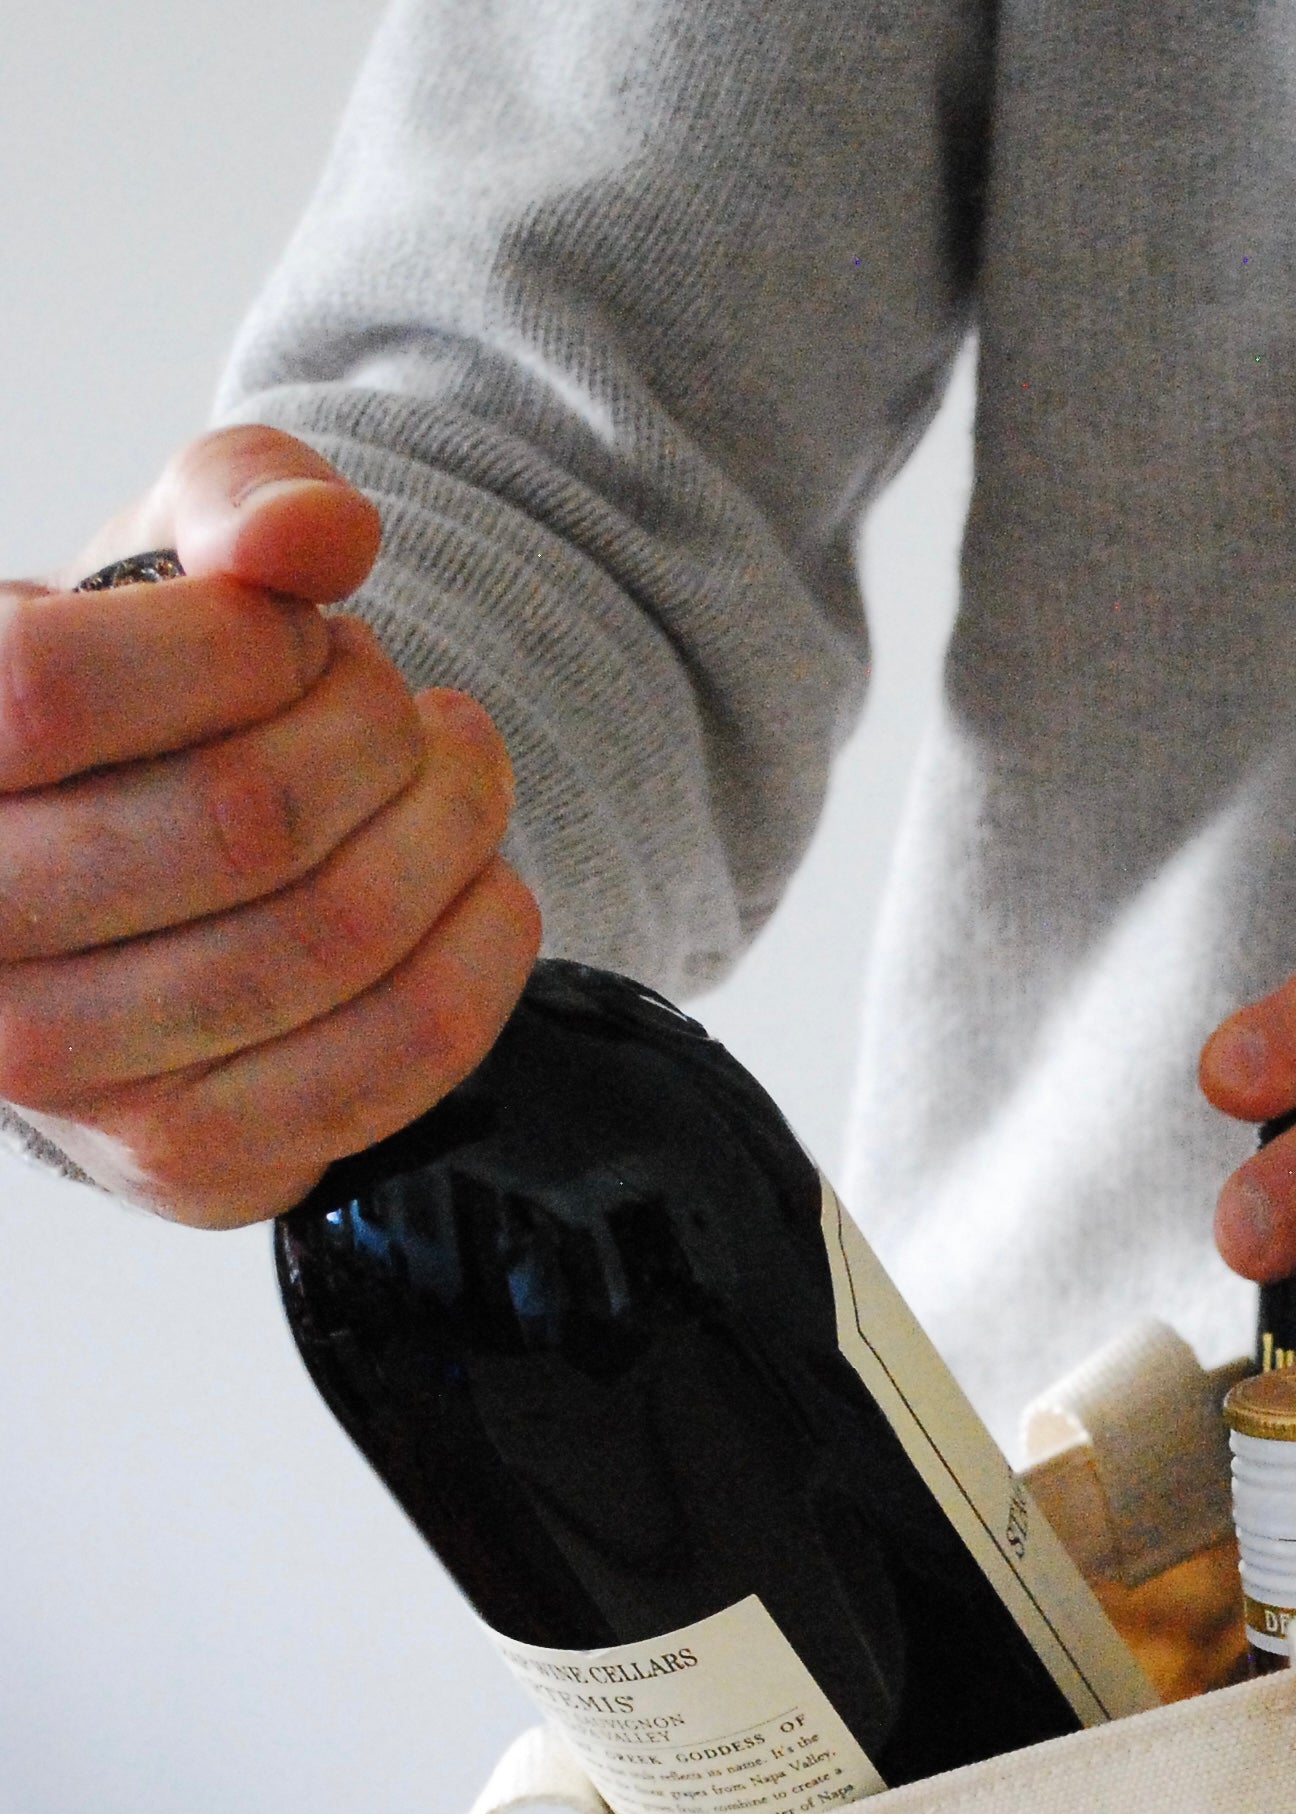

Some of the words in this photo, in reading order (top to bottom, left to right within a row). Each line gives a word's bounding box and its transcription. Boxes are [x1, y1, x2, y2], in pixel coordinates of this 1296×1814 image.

[589, 1648, 699, 1684] CELLARS
[675, 1733, 766, 1762] GODDESS
[780, 1713, 806, 1733] OF
[797, 1733, 819, 1749] the
[712, 1783, 746, 1796] from
[750, 1771, 787, 1786] Napa
[713, 1796, 768, 1813] combine
[773, 1790, 787, 1801] to
[791, 1772, 830, 1795] create
[835, 1767, 843, 1776] a
[800, 1798, 816, 1812] of
[817, 1783, 855, 1805] Napa
